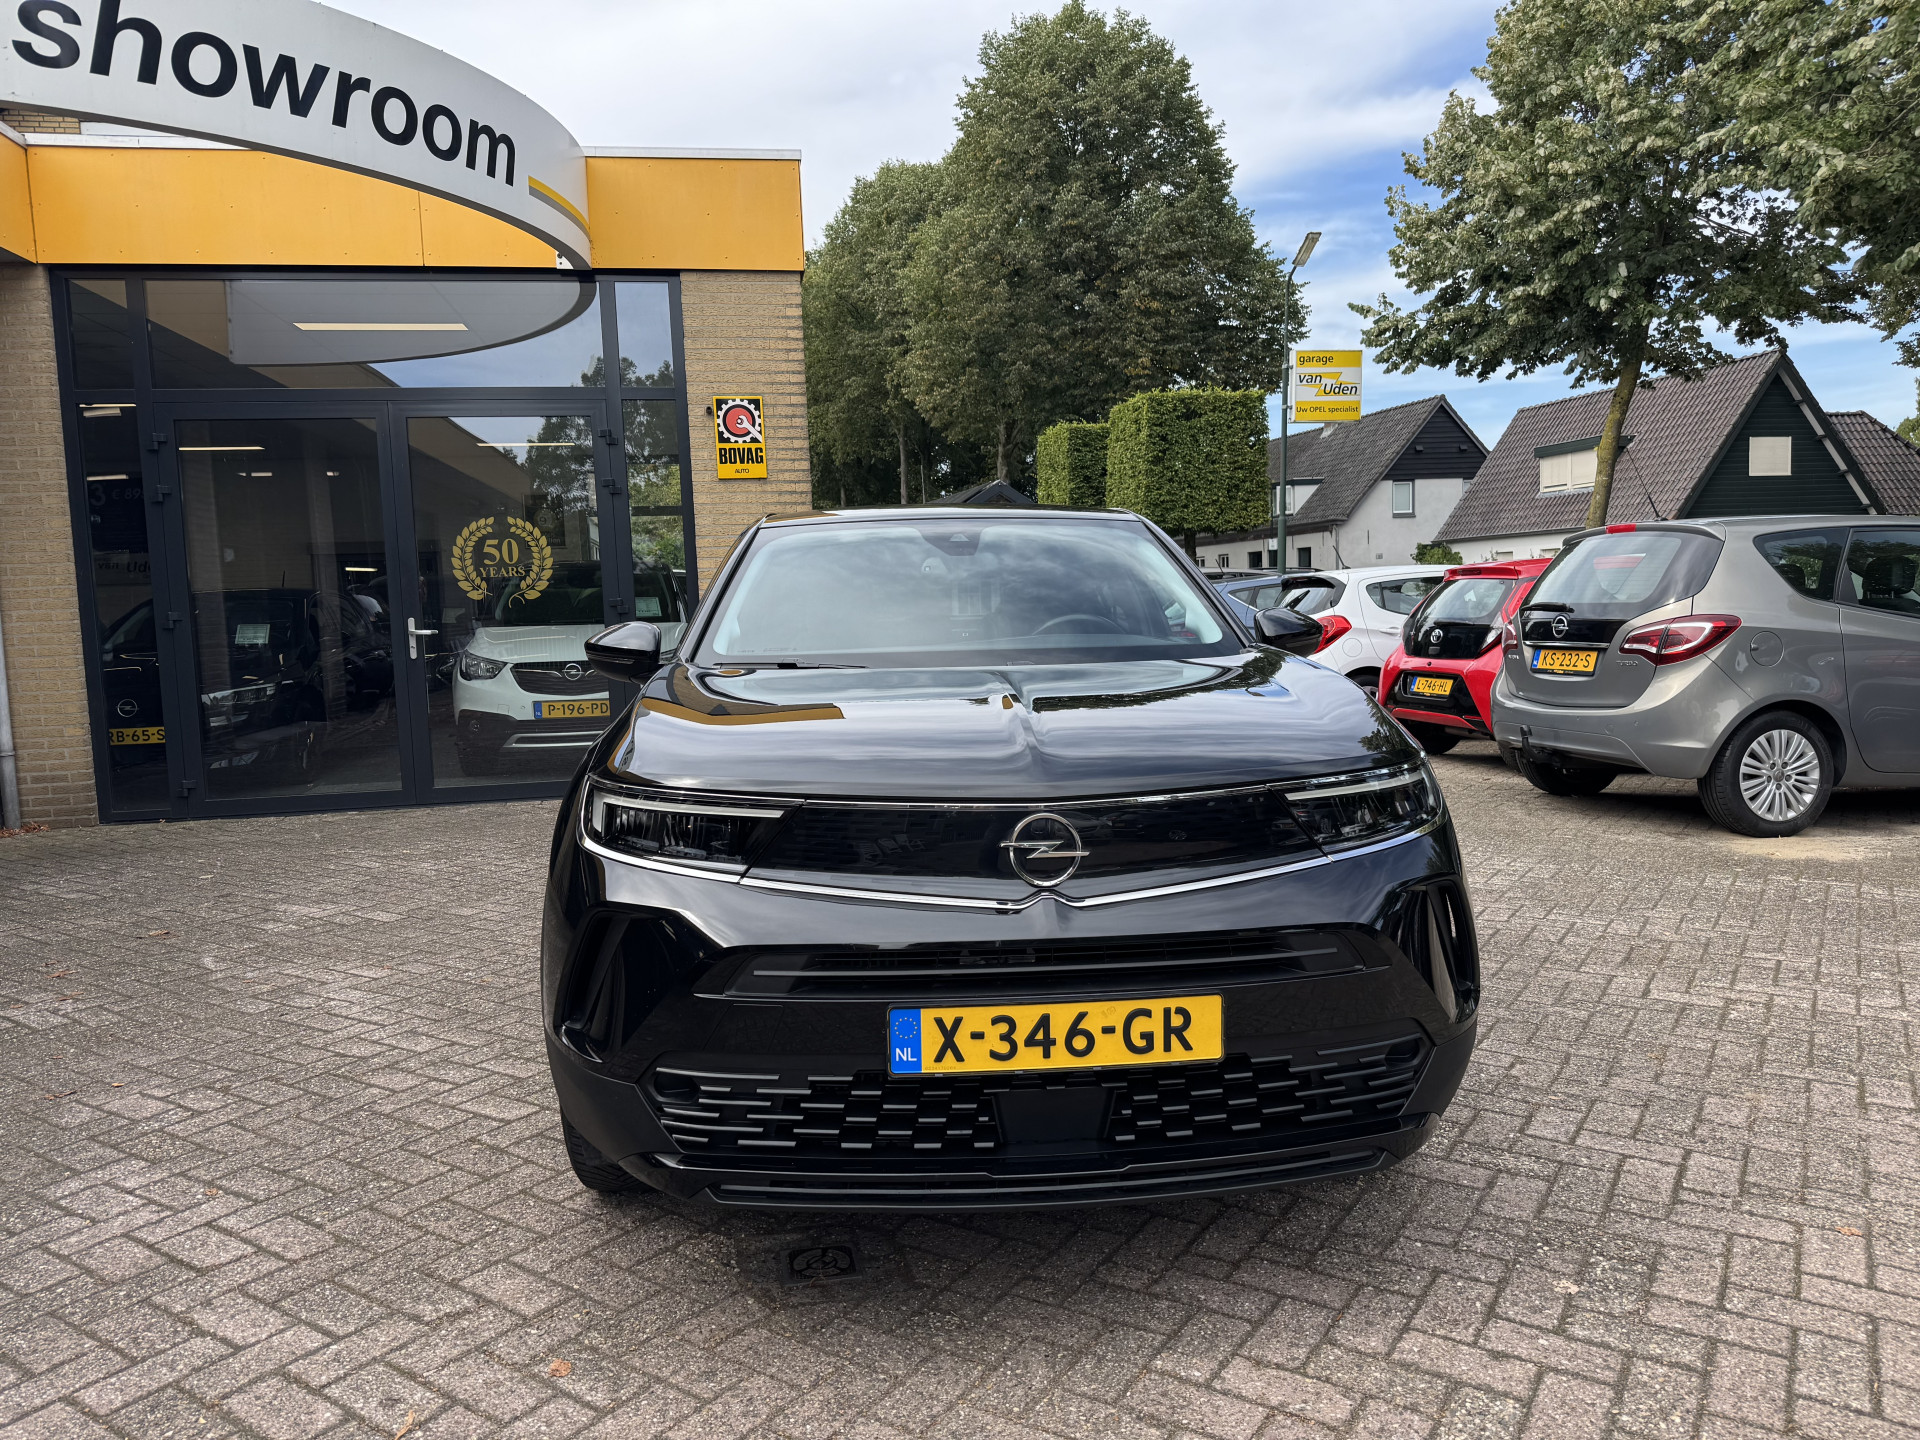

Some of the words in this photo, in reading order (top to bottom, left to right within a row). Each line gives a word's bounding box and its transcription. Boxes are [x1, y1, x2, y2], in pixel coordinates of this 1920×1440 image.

[11, 0, 517, 187] showroom
[1299, 355, 1334, 365] garage
[1299, 374, 1322, 384] van
[1323, 383, 1358, 395] Uden
[1328, 406, 1358, 414] specialist
[718, 447, 764, 465] BOVAG
[483, 538, 519, 565] 50
[479, 566, 526, 578] YEARS
[1541, 649, 1592, 668] KS-232-S
[1416, 679, 1449, 692] L-746-HL
[547, 702, 609, 716] P-196-PD
[933, 1006, 1194, 1063] X-346-GR
[895, 1047, 918, 1062] NL
